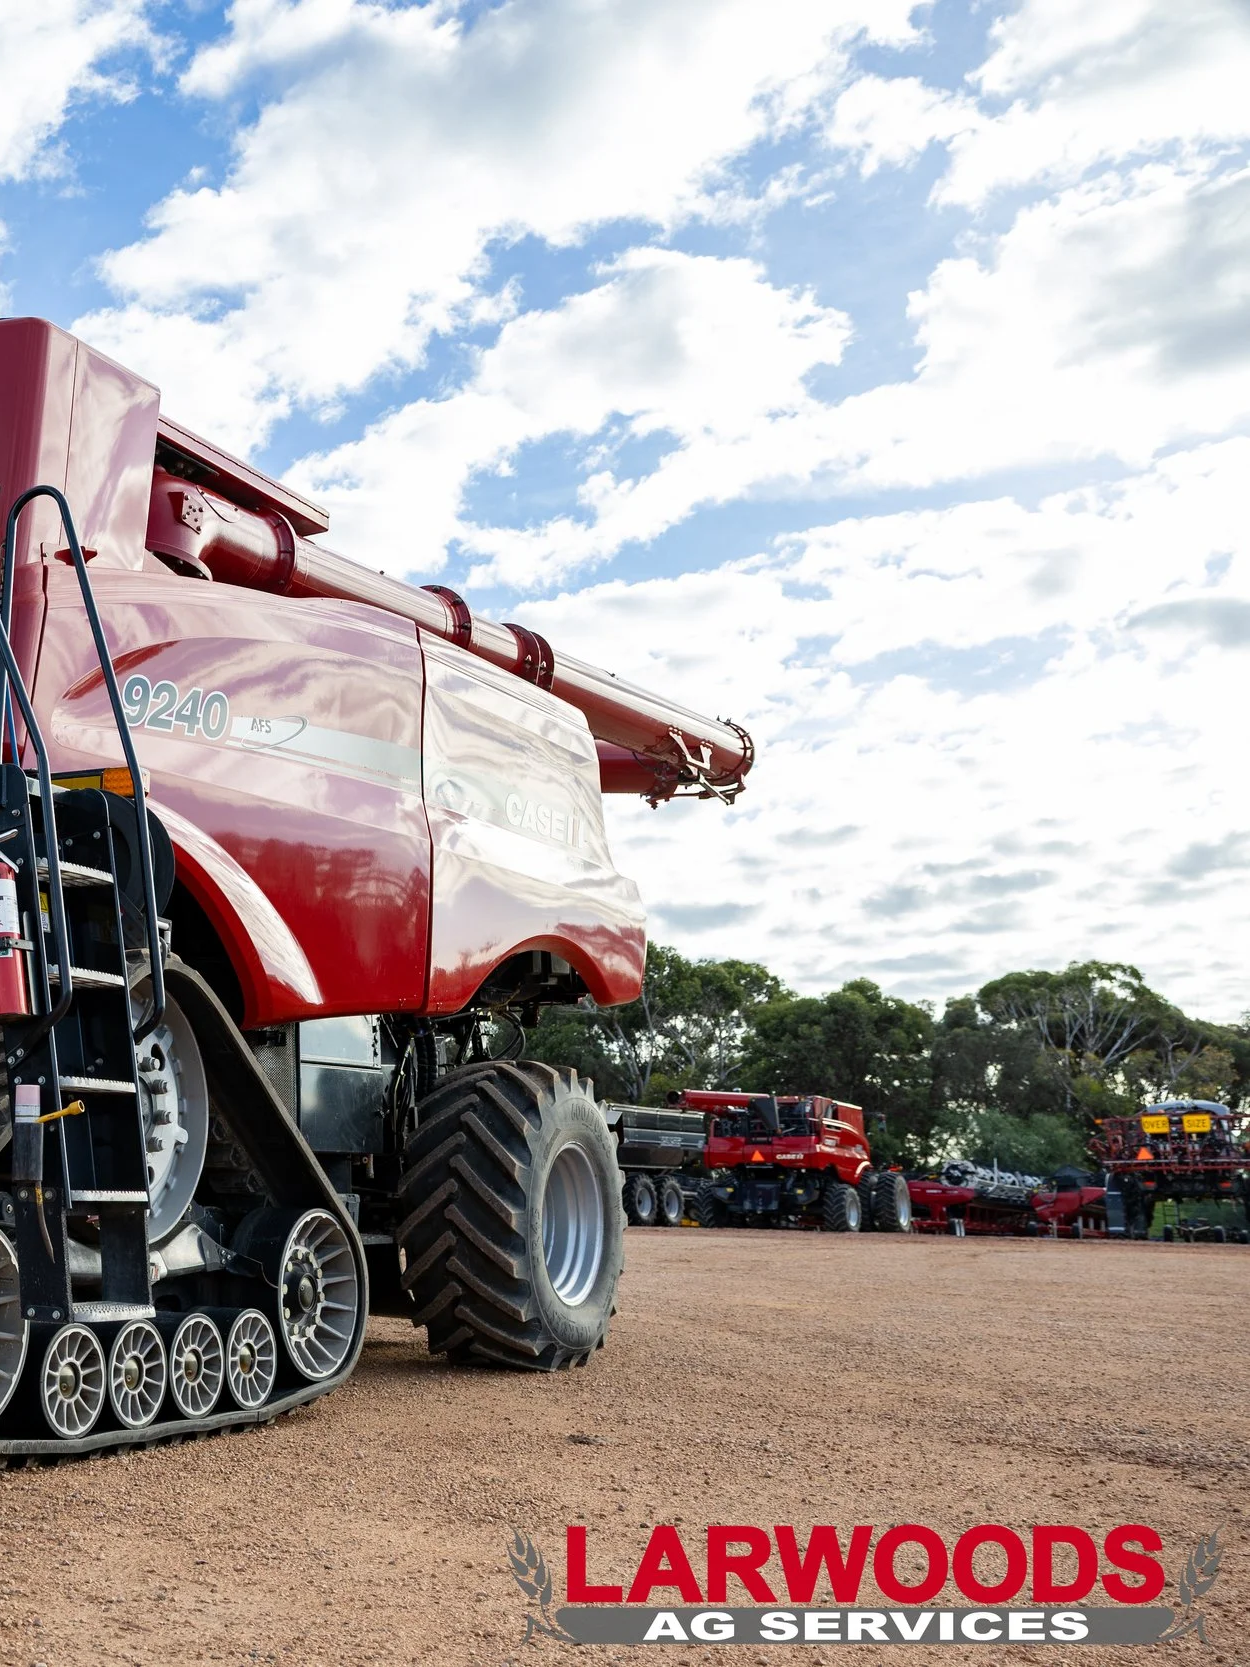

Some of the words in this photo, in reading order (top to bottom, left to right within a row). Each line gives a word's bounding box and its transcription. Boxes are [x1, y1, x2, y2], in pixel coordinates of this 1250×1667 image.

[122, 674, 229, 741] 9240
[250, 717, 272, 735] AFS
[1143, 1119, 1168, 1129] OVER
[1186, 1118, 1209, 1128] SIZE
